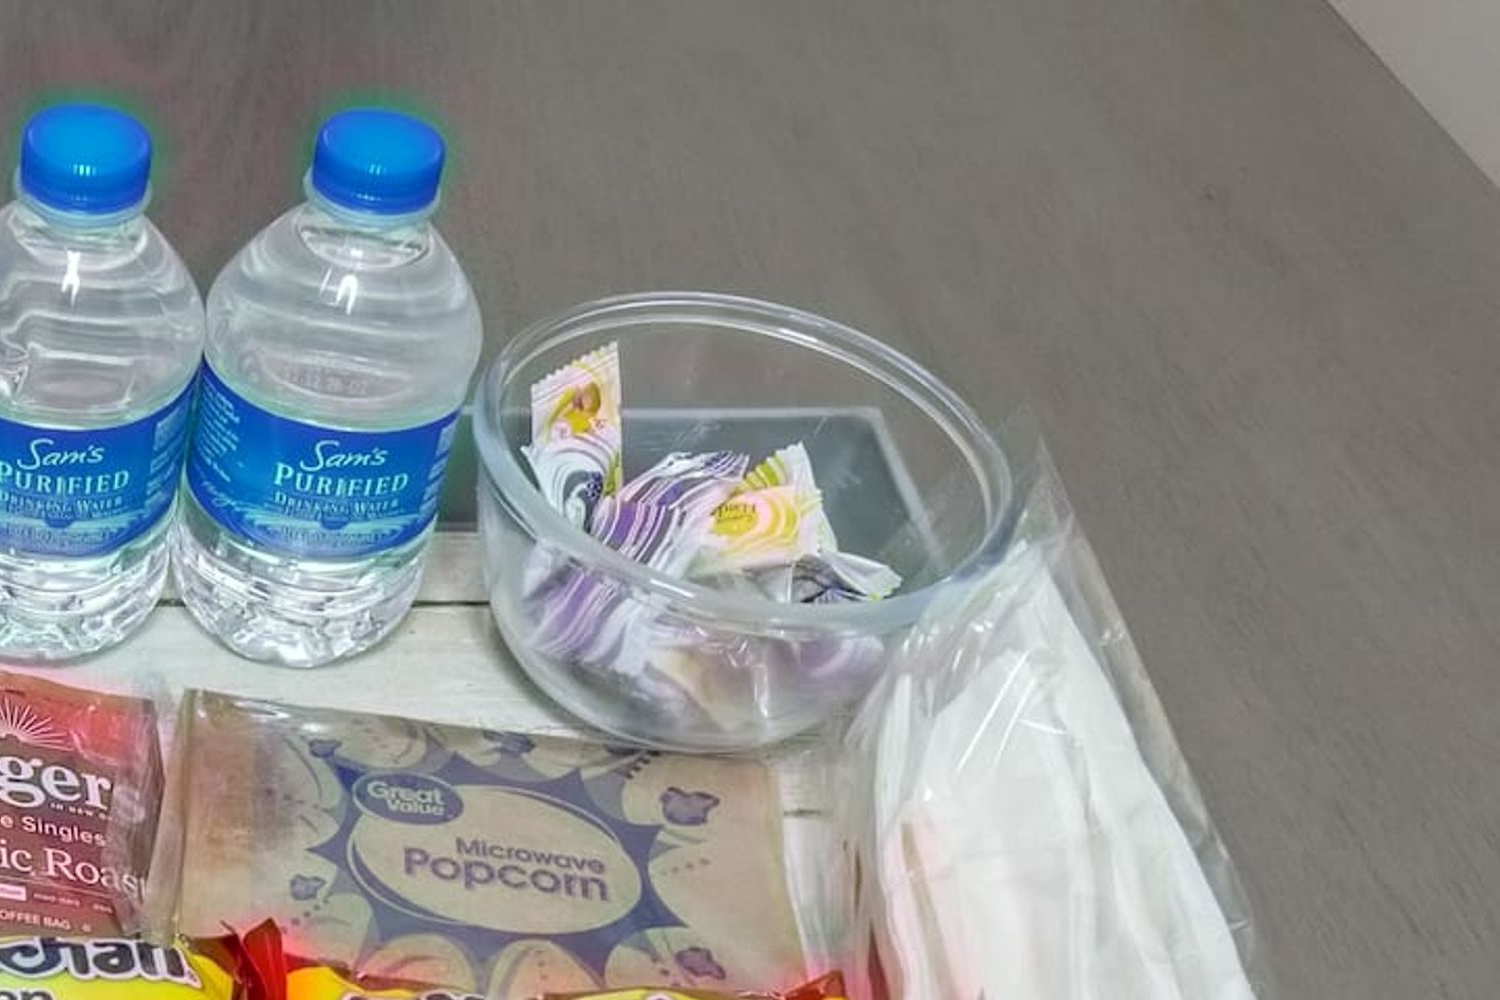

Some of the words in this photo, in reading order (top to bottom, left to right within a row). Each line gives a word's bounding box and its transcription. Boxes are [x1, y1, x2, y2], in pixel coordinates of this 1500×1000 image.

[16, 437, 105, 470] Sam's
[300, 439, 389, 472] Sam's
[273, 462, 409, 497] PURIFIED
[367, 780, 442, 806] Great
[386, 798, 447, 816] Value
[22, 815, 108, 847] Singles
[455, 837, 606, 875] Microwave
[402, 846, 611, 902] Popcorn
[43, 915, 71, 931] BAG
